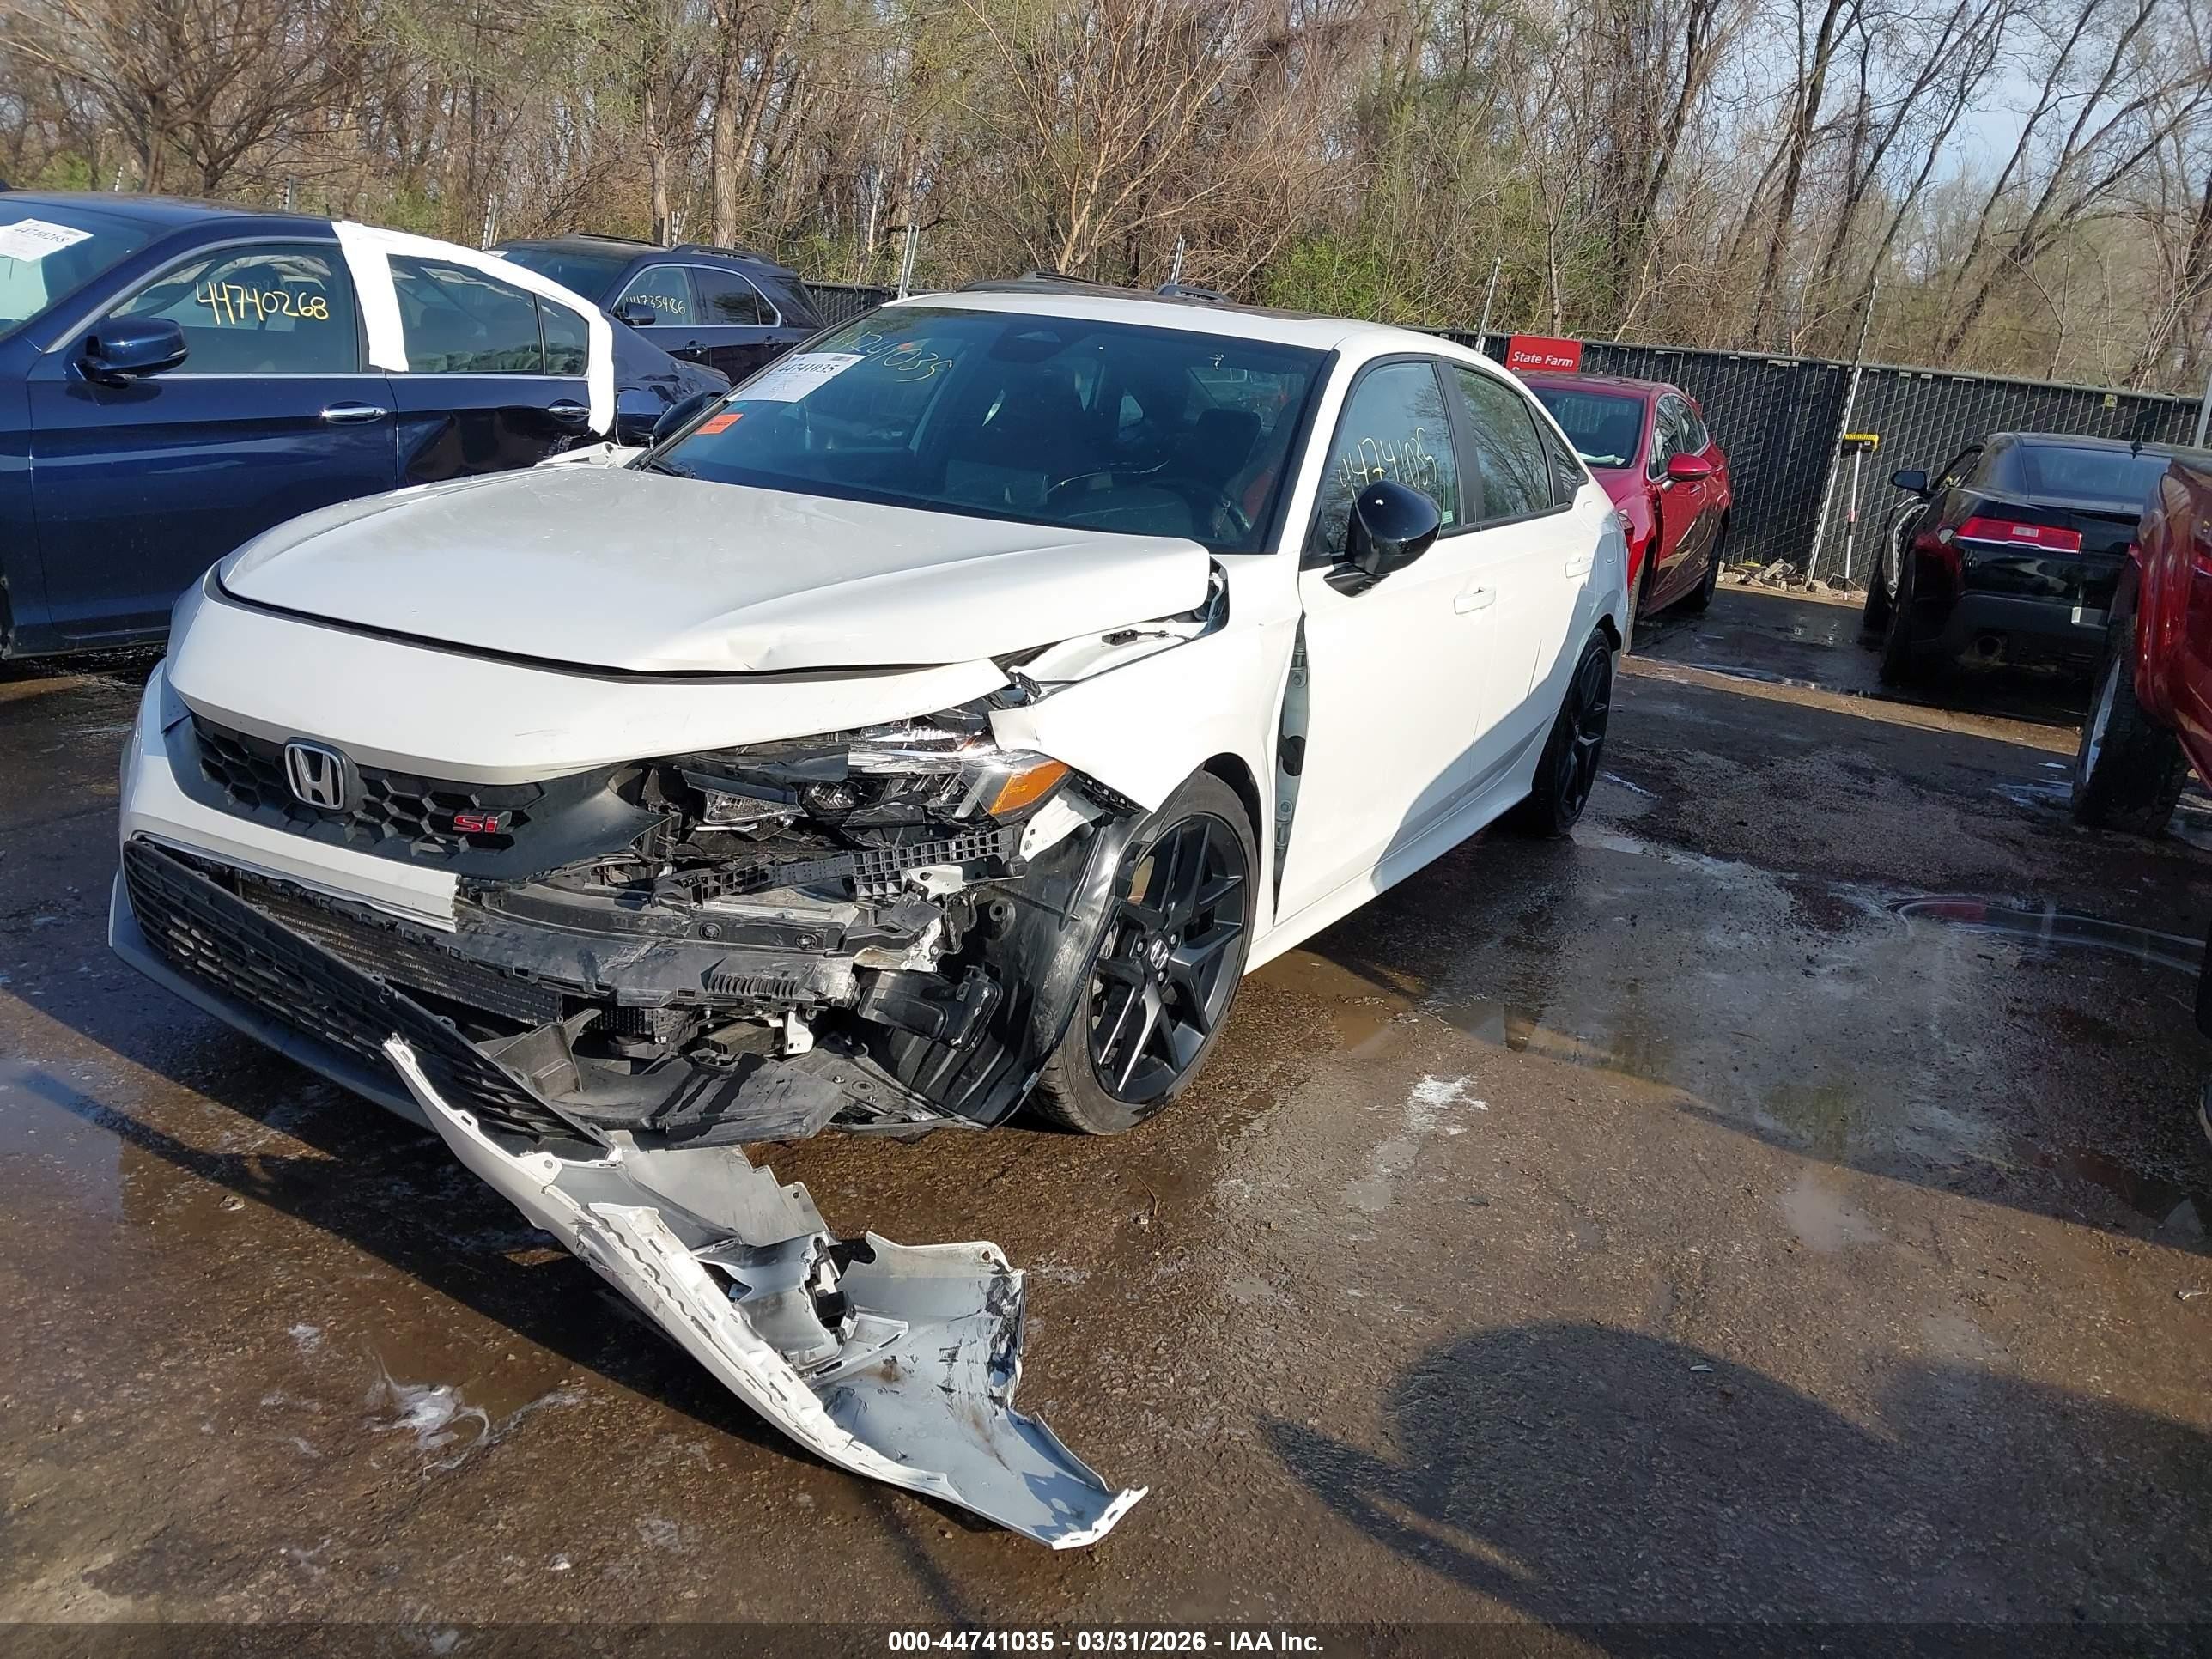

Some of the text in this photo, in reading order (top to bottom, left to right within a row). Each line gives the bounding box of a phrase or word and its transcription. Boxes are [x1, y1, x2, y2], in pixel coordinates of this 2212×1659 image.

[196, 281, 330, 325] 44740268
[1512, 350, 1574, 368] State Farm
[453, 814, 502, 834] Si
